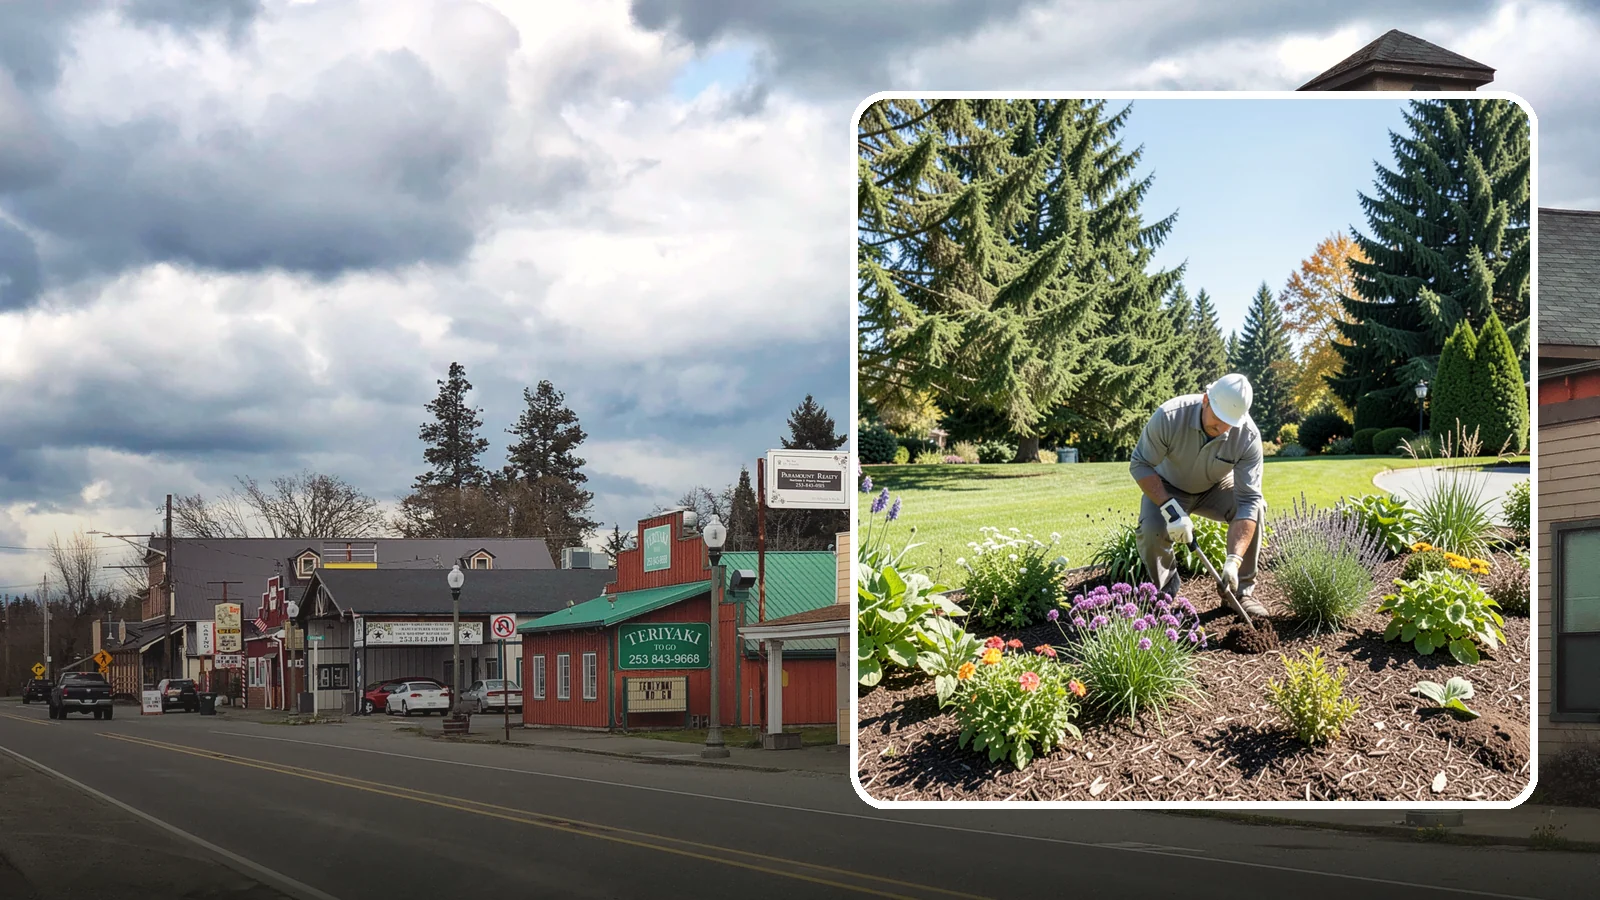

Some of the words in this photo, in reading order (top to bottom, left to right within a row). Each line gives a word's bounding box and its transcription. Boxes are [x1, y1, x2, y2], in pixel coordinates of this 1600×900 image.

[624, 627, 703, 646] TERIYAKI
[629, 654, 648, 664] 253
[651, 653, 700, 664] 843-9668
